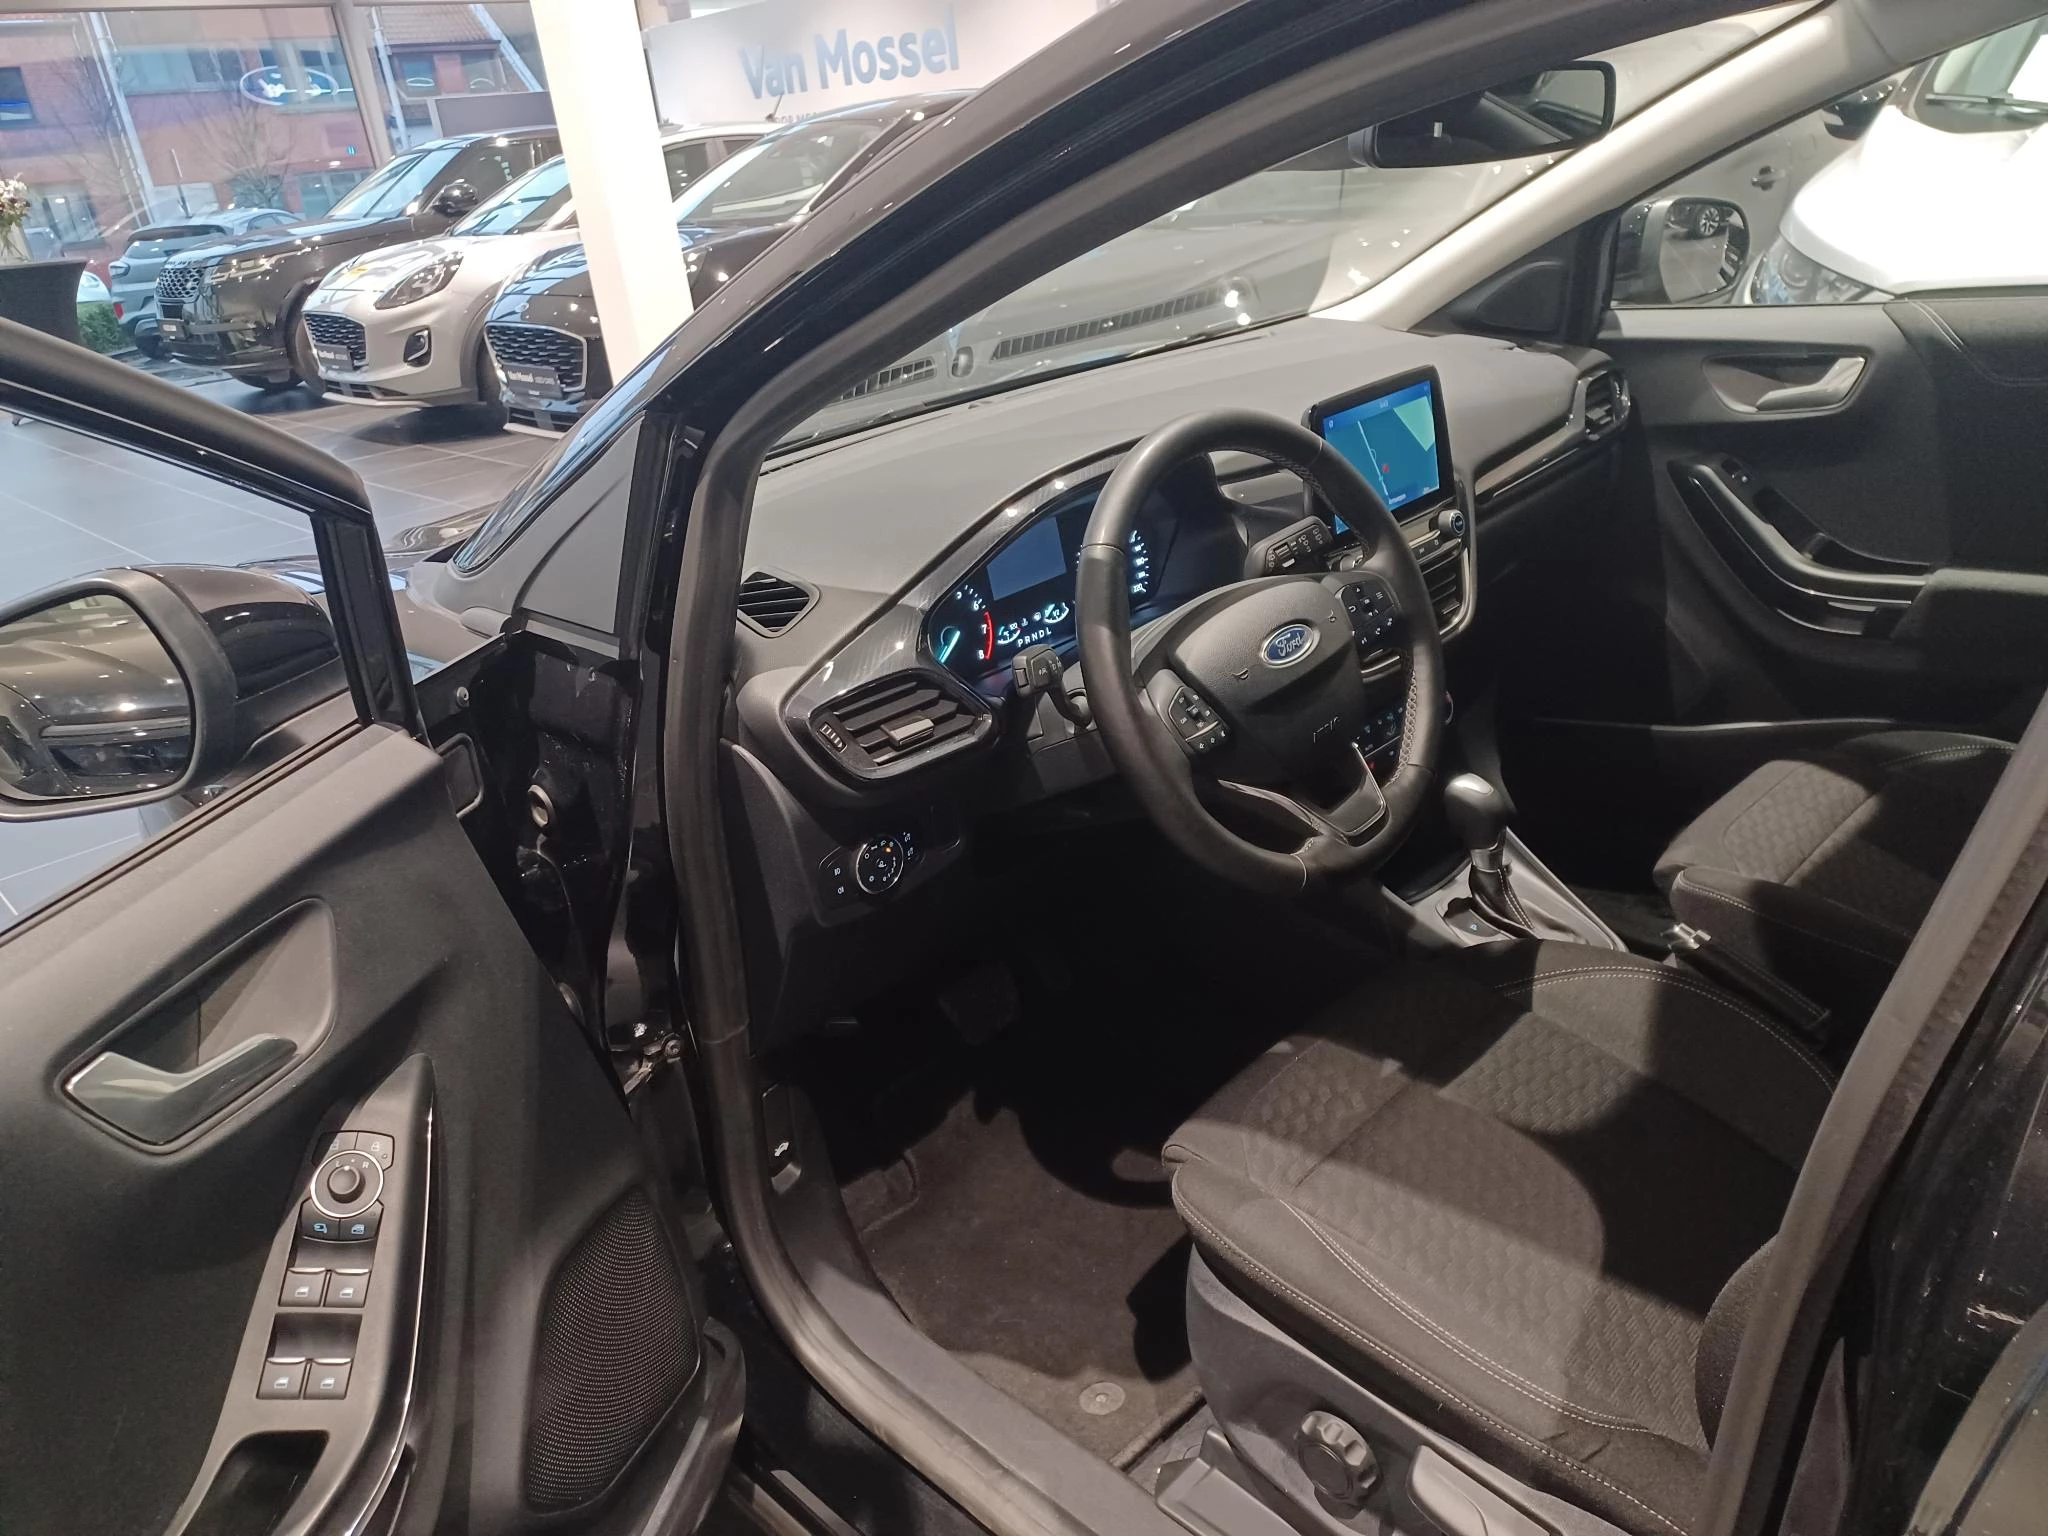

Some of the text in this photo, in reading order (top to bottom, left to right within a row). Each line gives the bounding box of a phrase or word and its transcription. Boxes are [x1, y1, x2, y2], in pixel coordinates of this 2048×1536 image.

[738, 3, 959, 99] Van Mossel
[973, 601, 979, 610] 6
[981, 624, 987, 634] 7
[1275, 632, 1303, 657] Ford
